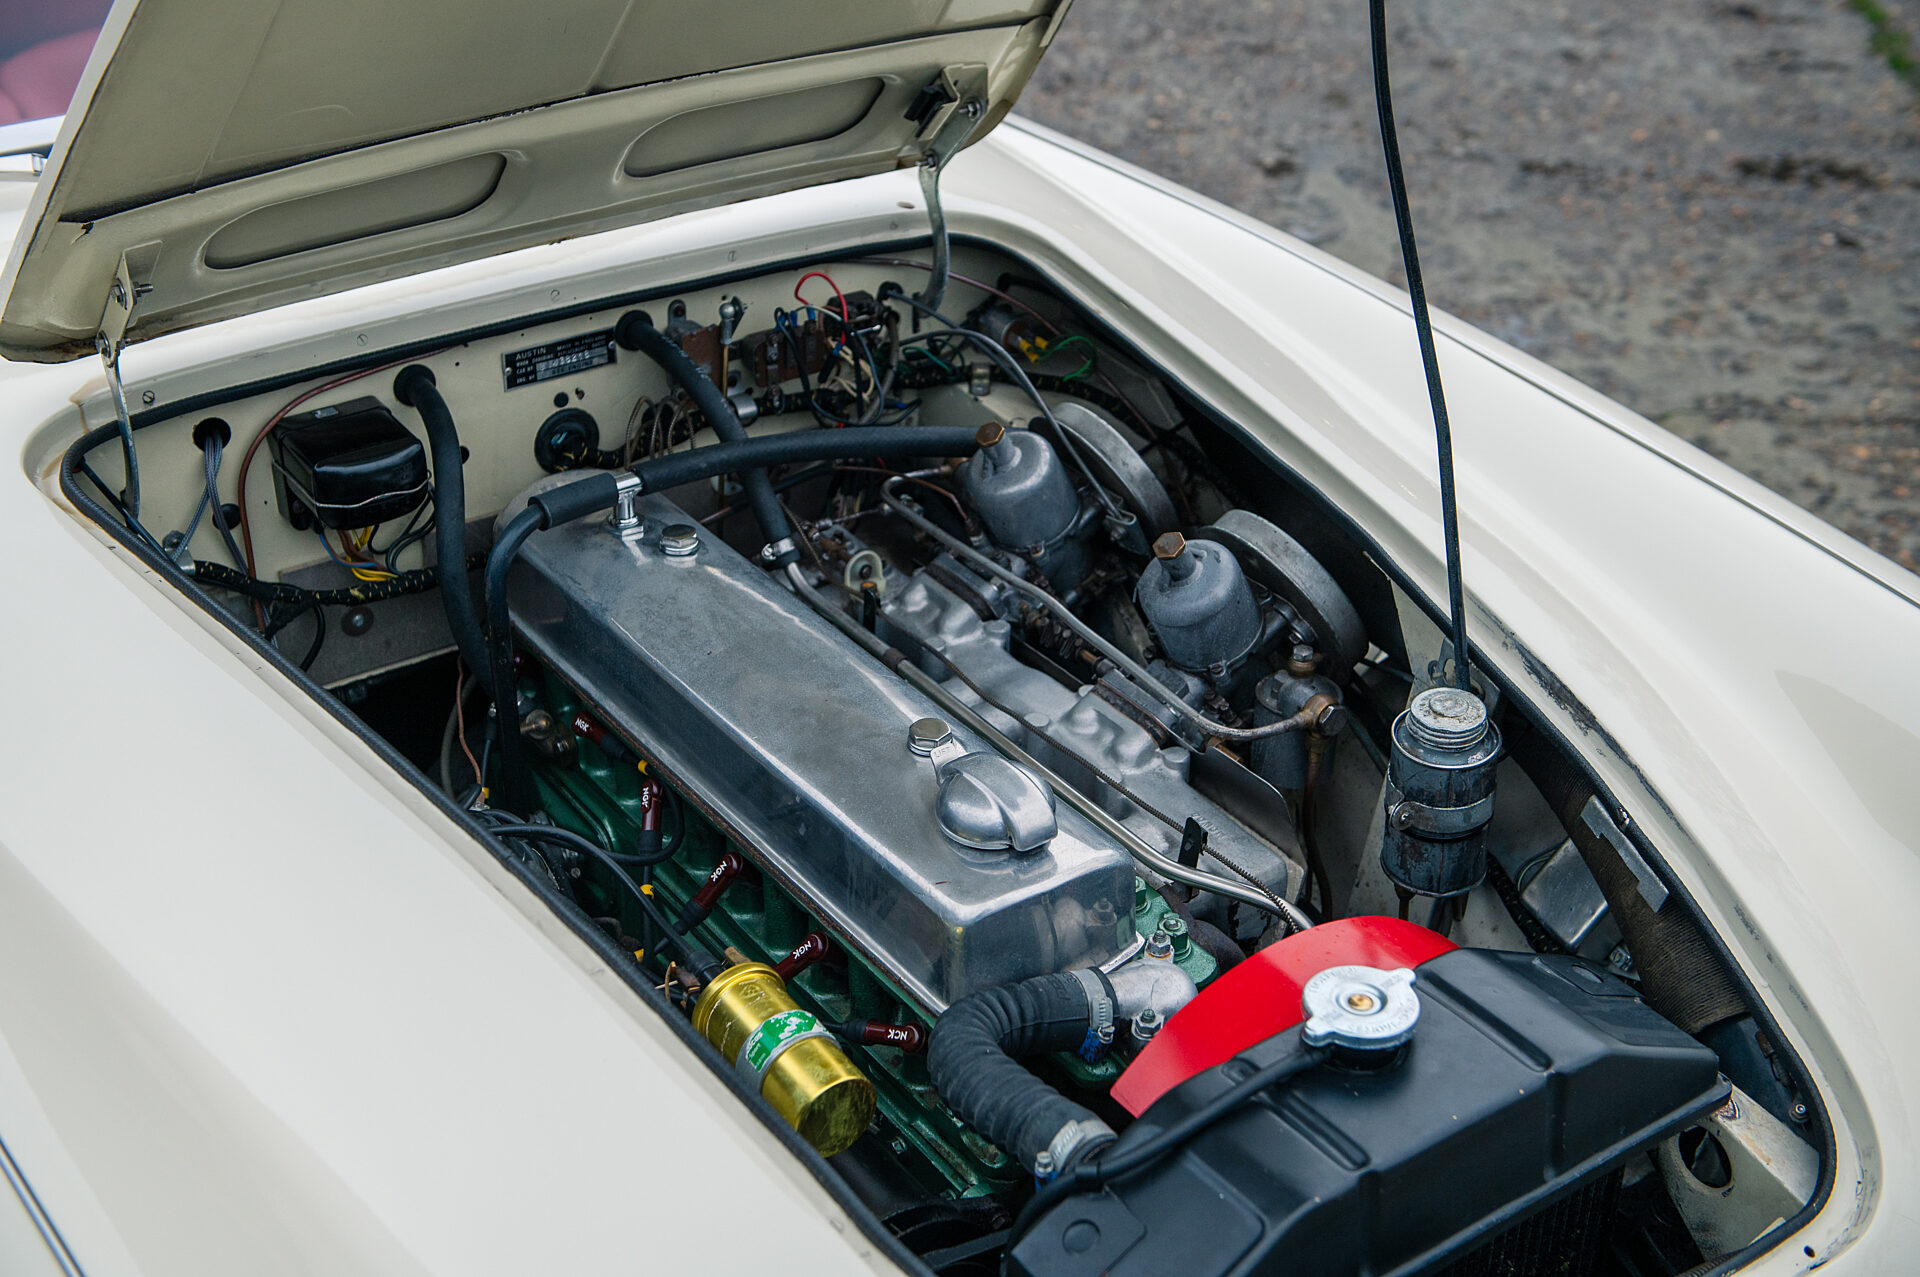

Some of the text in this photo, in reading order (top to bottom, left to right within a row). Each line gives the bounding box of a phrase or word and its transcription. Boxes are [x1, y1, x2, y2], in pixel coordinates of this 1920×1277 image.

[516, 347, 546, 360] AUSTIN
[575, 718, 589, 732] NGK
[711, 861, 727, 882] NGK
[793, 941, 811, 959] NGK
